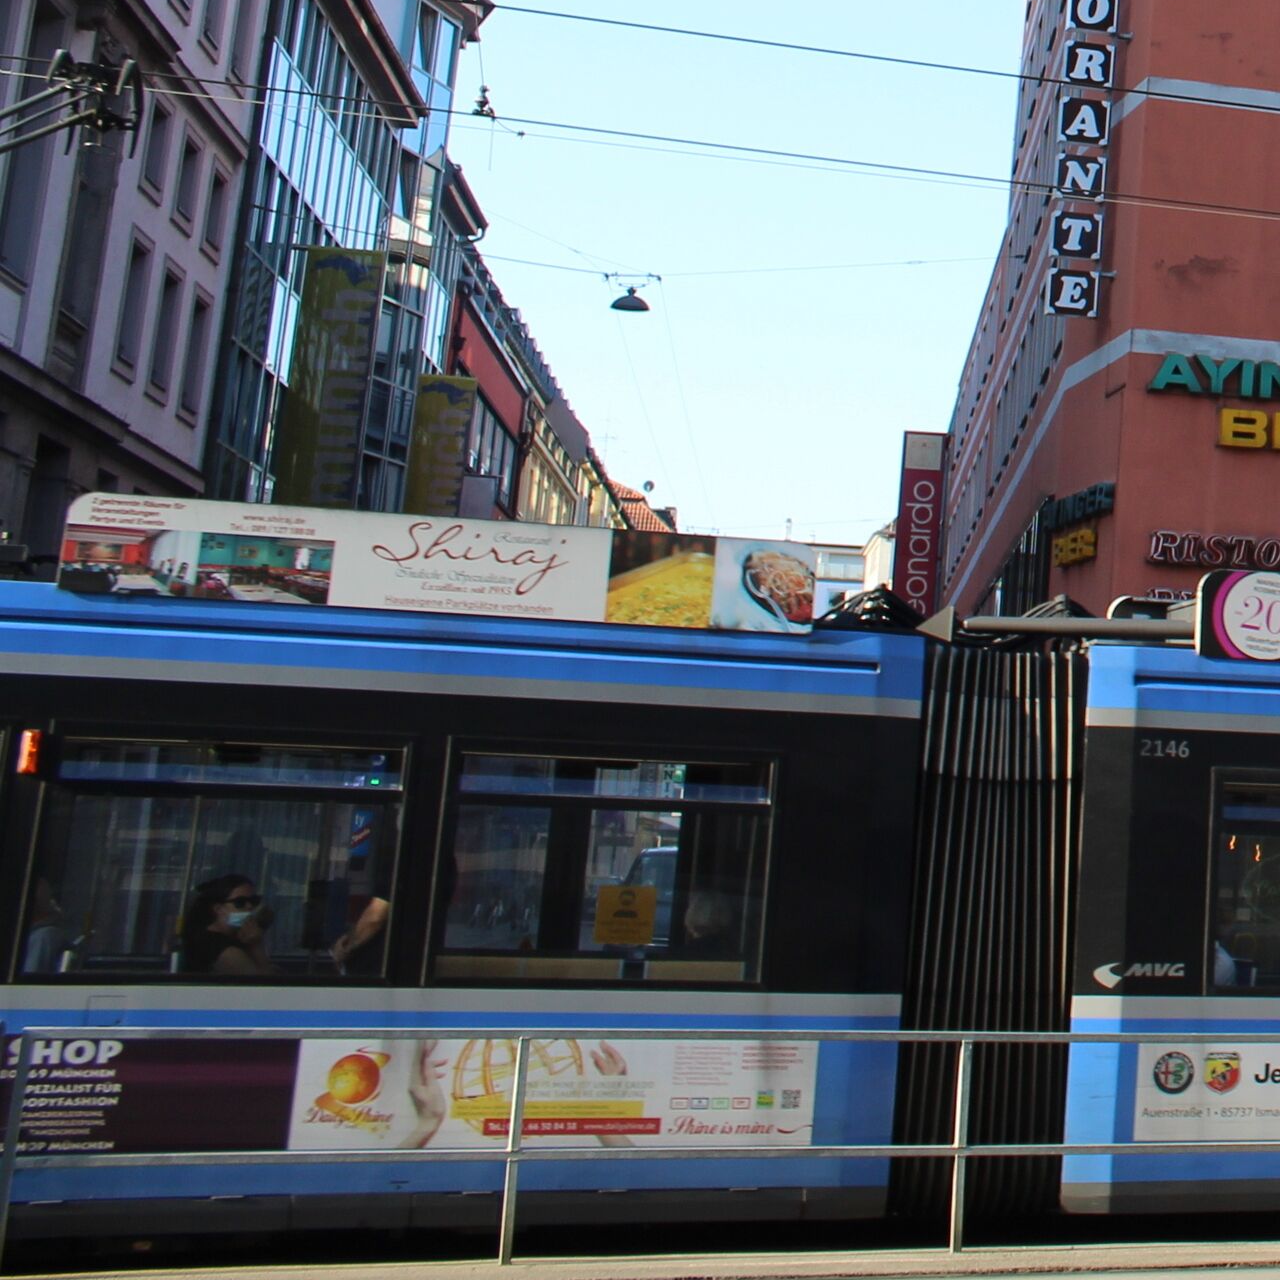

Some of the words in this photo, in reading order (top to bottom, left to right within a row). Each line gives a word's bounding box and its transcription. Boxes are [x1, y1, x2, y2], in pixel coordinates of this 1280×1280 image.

[905, 480, 935, 615] eonardo
[371, 521, 569, 596] Shiraj
[1140, 738, 1190, 759] 2146
[1124, 962, 1185, 978] MVG
[49, 1068, 117, 1080] MÜNCHEN
[24, 1083, 93, 1095] PEZIALIST
[94, 1081, 123, 1094] FÜR
[21, 1096, 120, 1108] ODYFASHION
[1142, 1106, 1203, 1118] Auenstraße
[1219, 1106, 1253, 1117] 85737
[667, 1114, 716, 1135] Shine
[719, 1120, 733, 1134] is
[734, 1121, 776, 1135] mine
